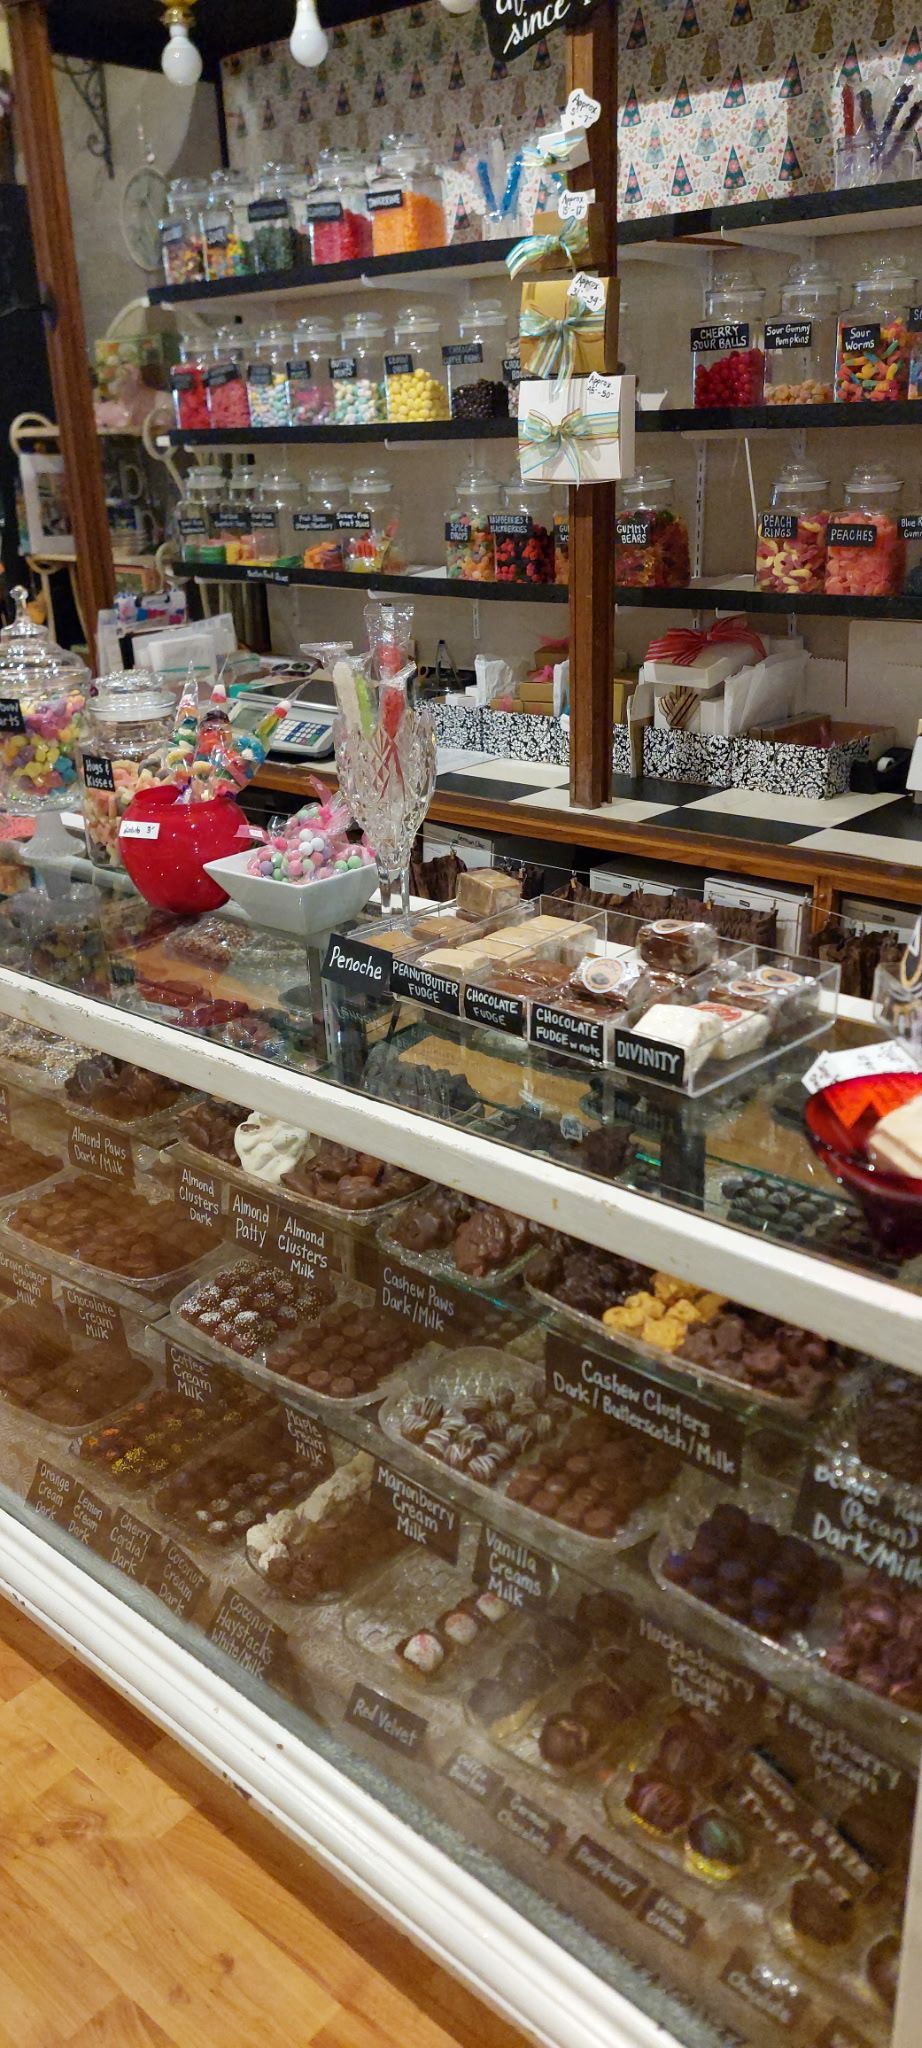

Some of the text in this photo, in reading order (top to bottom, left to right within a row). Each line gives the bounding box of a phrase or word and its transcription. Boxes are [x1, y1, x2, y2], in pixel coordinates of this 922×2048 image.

[503, 0, 571, 54] since
[572, 94, 597, 113] Approx
[575, 275, 599, 290] Approx
[692, 335, 747, 351] SOUR BALLS
[700, 326, 740, 340] CHERRY
[766, 324, 811, 336] Sour Gummy
[775, 335, 809, 347] Pumpkins
[850, 328, 870, 340] Sour
[845, 339, 875, 351] Worms
[588, 375, 611, 388] Approx
[616, 523, 648, 534] GUMMY
[763, 515, 792, 528] PEACH
[763, 527, 792, 538] RINGS
[830, 528, 874, 542] PEACHES
[901, 518, 916, 528] Blue
[621, 533, 647, 544] BEARS
[85, 758, 104, 774] Hugs
[86, 774, 113, 788] Kisses
[329, 945, 382, 980] Penoche
[392, 960, 459, 997] PEANUTBUTTER
[408, 983, 440, 1004] FUDGE
[466, 988, 519, 1014] CHOCOLATE
[473, 1006, 506, 1026] FUDGE
[536, 1007, 599, 1039] CHOCOLATE
[536, 1026, 569, 1045] FUDGE
[579, 1042, 600, 1058] nuts
[617, 1040, 680, 1074] DIVINITY
[72, 1126, 126, 1159] Almond Paws
[74, 1144, 97, 1165] Dark
[181, 1168, 214, 1197] Almond
[179, 1186, 219, 1215] Clusters
[232, 1194, 270, 1227] Almond
[189, 1208, 213, 1227] Dark
[235, 1217, 266, 1248] Patty
[283, 1216, 325, 1249] Almond
[277, 1234, 328, 1268] Clusters
[290, 1259, 315, 1279] Milk
[12, 1272, 41, 1298] Cream
[16, 1289, 38, 1309] Milk
[383, 1267, 454, 1316] Cashew Paws
[67, 1290, 116, 1318] Chocolate
[78, 1307, 114, 1330] Cream
[85, 1323, 109, 1340] Milk
[170, 1347, 209, 1377] Coffee
[173, 1364, 212, 1393] Cream
[177, 1379, 204, 1402] Milk
[553, 1371, 590, 1403] Dark
[581, 1360, 710, 1438] Cashew Clusters
[285, 1407, 322, 1438] Maple
[287, 1422, 327, 1454] Cream
[296, 1440, 324, 1466] Milk
[40, 1463, 70, 1493] Orange
[38, 1480, 64, 1507] Cream
[77, 1489, 103, 1521] Lemon
[377, 1466, 455, 1530] Marionberry
[35, 1500, 57, 1521] Dark
[73, 1505, 98, 1533] Cream
[392, 1492, 438, 1533] Cream
[68, 1520, 89, 1545] Dark
[110, 1526, 149, 1562] Cordial
[120, 1514, 151, 1546] Cherry
[397, 1515, 427, 1544] Milk
[111, 1547, 137, 1576] Dark
[486, 1527, 537, 1574] Vanilla
[163, 1563, 193, 1602] Cream
[167, 1548, 205, 1588] Coconut
[489, 1552, 542, 1597] Creams
[158, 1583, 185, 1616] Dark
[488, 1575, 524, 1607] Milk
[229, 1594, 275, 1636] Coconut
[216, 1606, 273, 1665] Haystacks
[353, 1699, 417, 1747] Red Velvet
